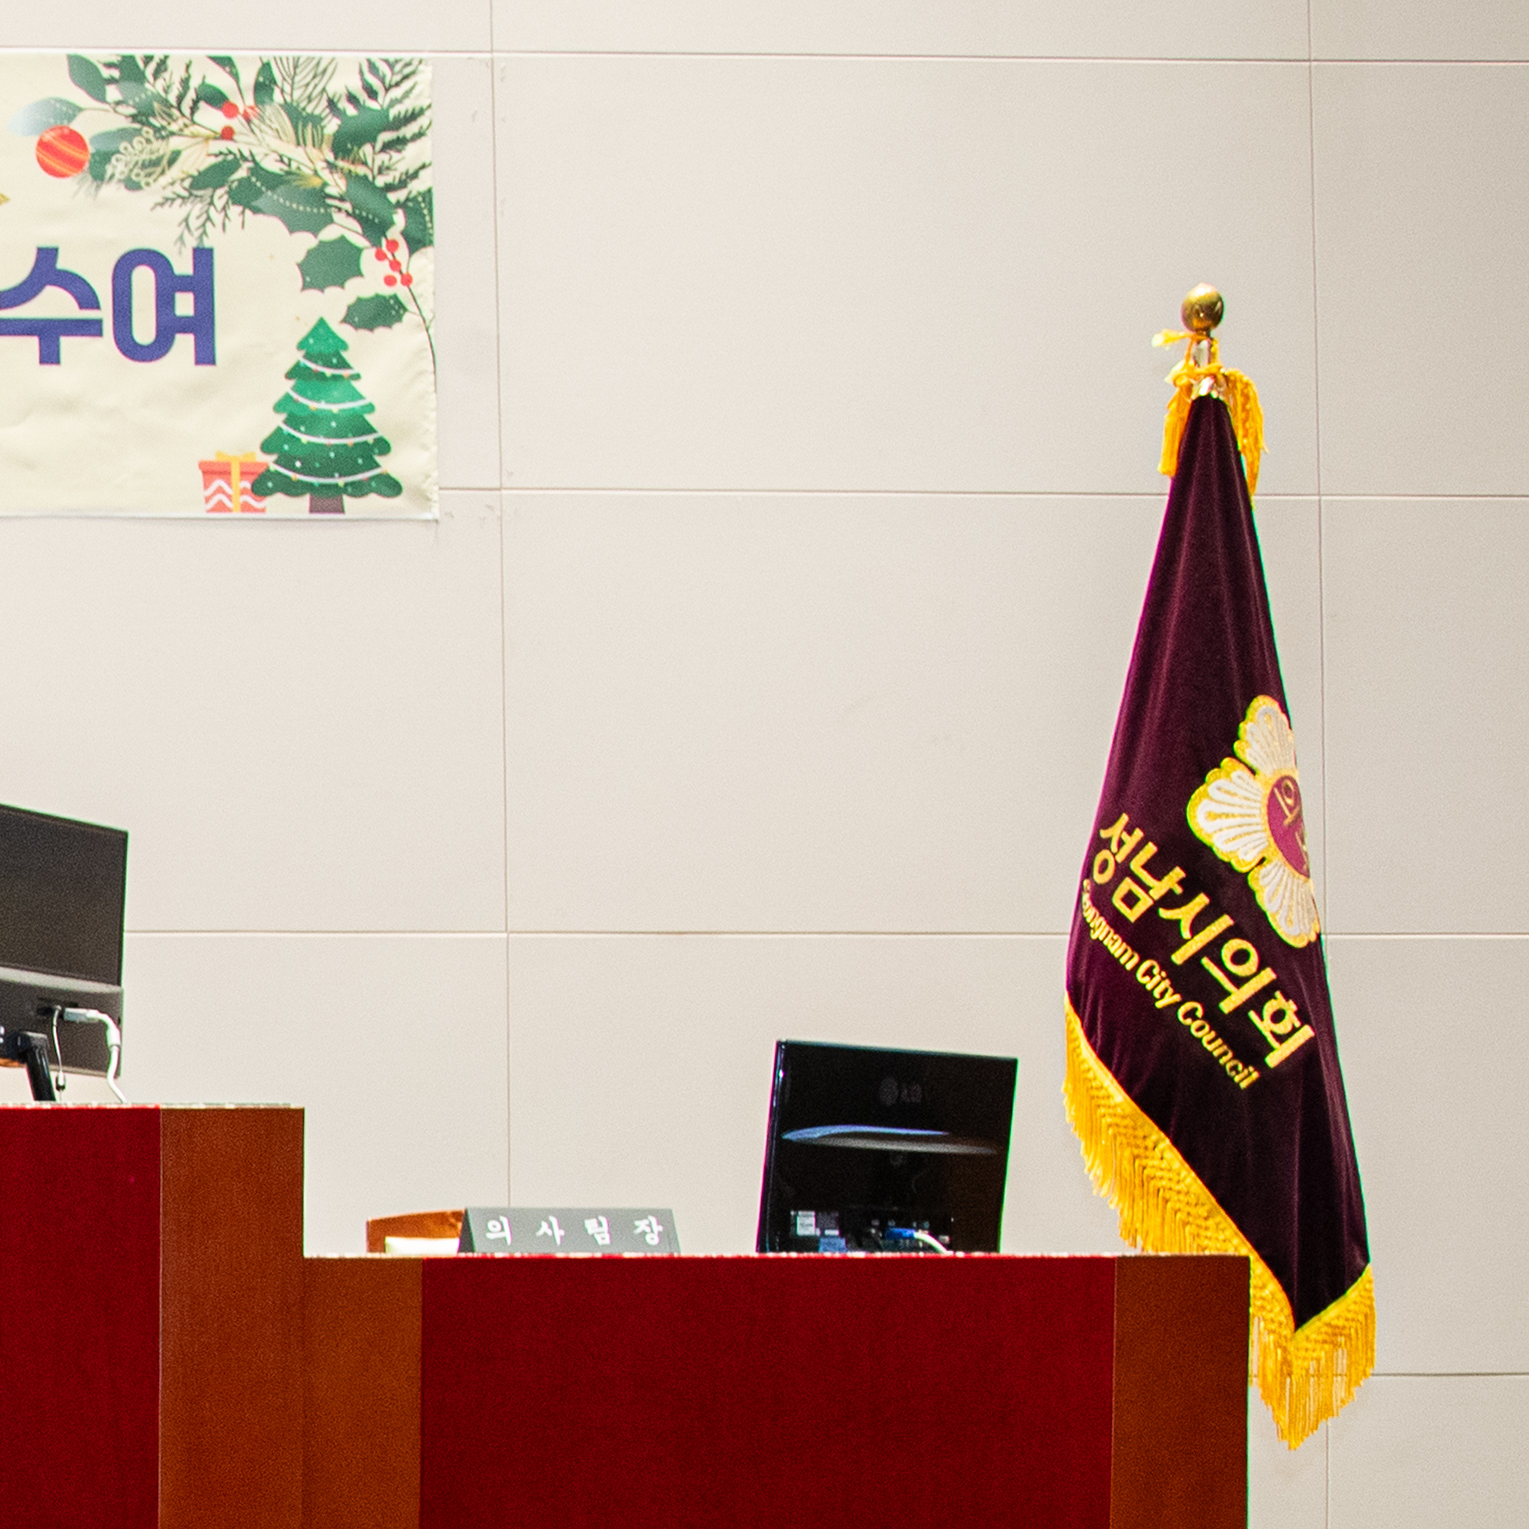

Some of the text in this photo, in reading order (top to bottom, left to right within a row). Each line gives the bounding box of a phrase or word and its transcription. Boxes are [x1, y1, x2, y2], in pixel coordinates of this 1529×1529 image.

[1093, 813, 1315, 1068] 성남시의회
[1135, 958, 1183, 1010] City
[1176, 1000, 1261, 1090] Council
